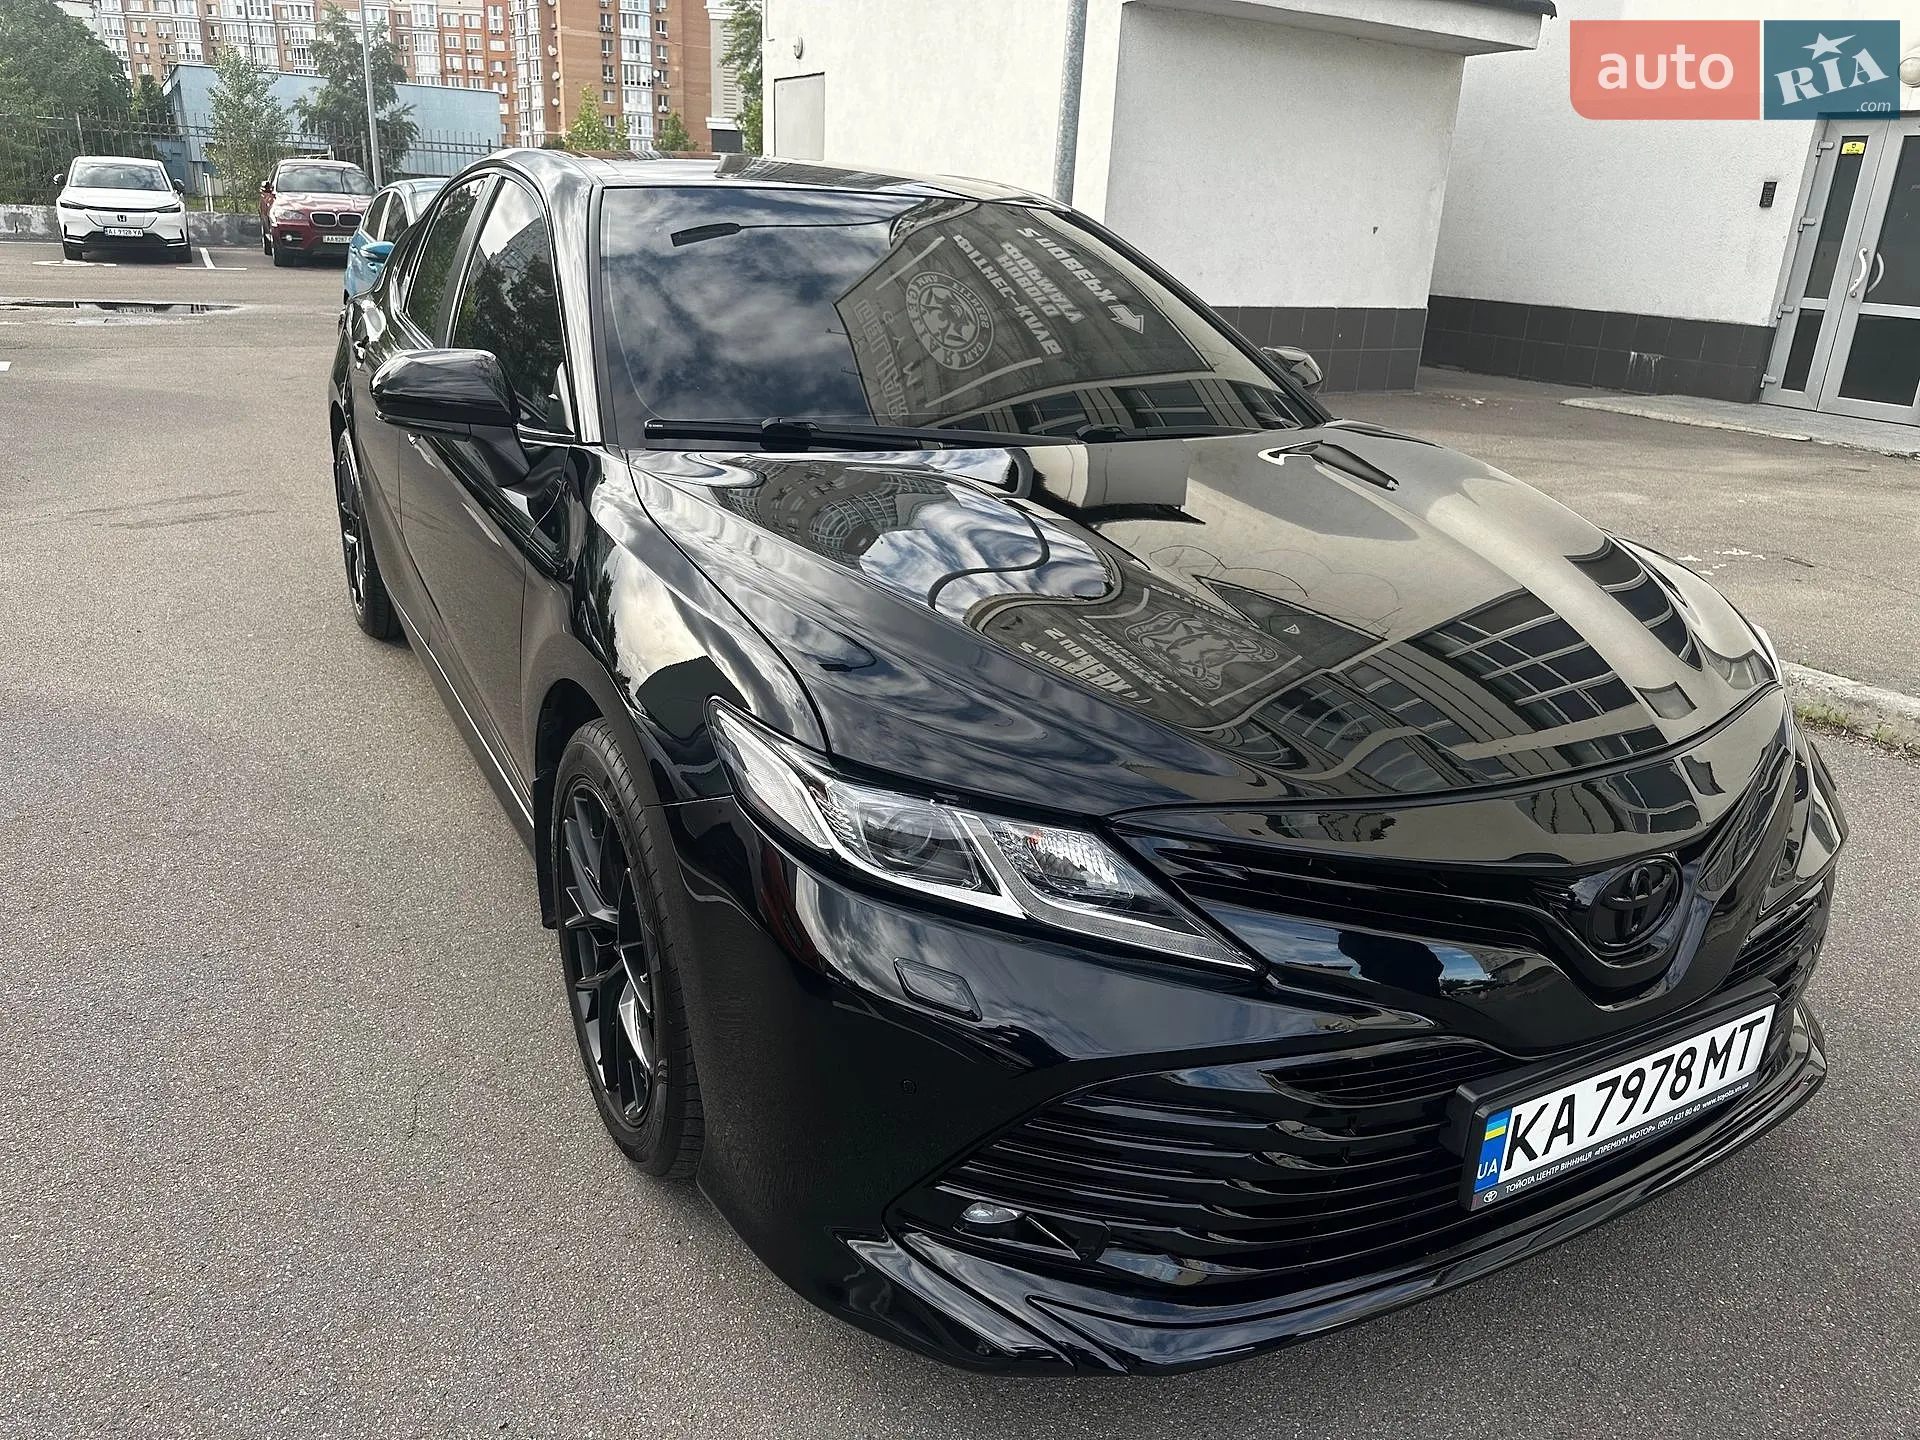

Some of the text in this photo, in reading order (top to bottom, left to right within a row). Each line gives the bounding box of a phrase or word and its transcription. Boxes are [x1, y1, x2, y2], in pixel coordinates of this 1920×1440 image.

[1503, 1015, 1767, 1172] KA 7978 MT
[1476, 1158, 1499, 1180] UA
[1505, 1175, 1536, 1194] ТОЙОТА
[1536, 1165, 1560, 1182] ЦЕНТР
[1560, 1151, 1593, 1171] ВІННИЦЯ
[1628, 1126, 1656, 1142] МОТОР»
[1657, 1115, 1674, 1130] (067)
[1674, 1112, 1684, 1121] 431
[1684, 1107, 1693, 1116] 80
[1693, 1103, 1701, 1113] 40
